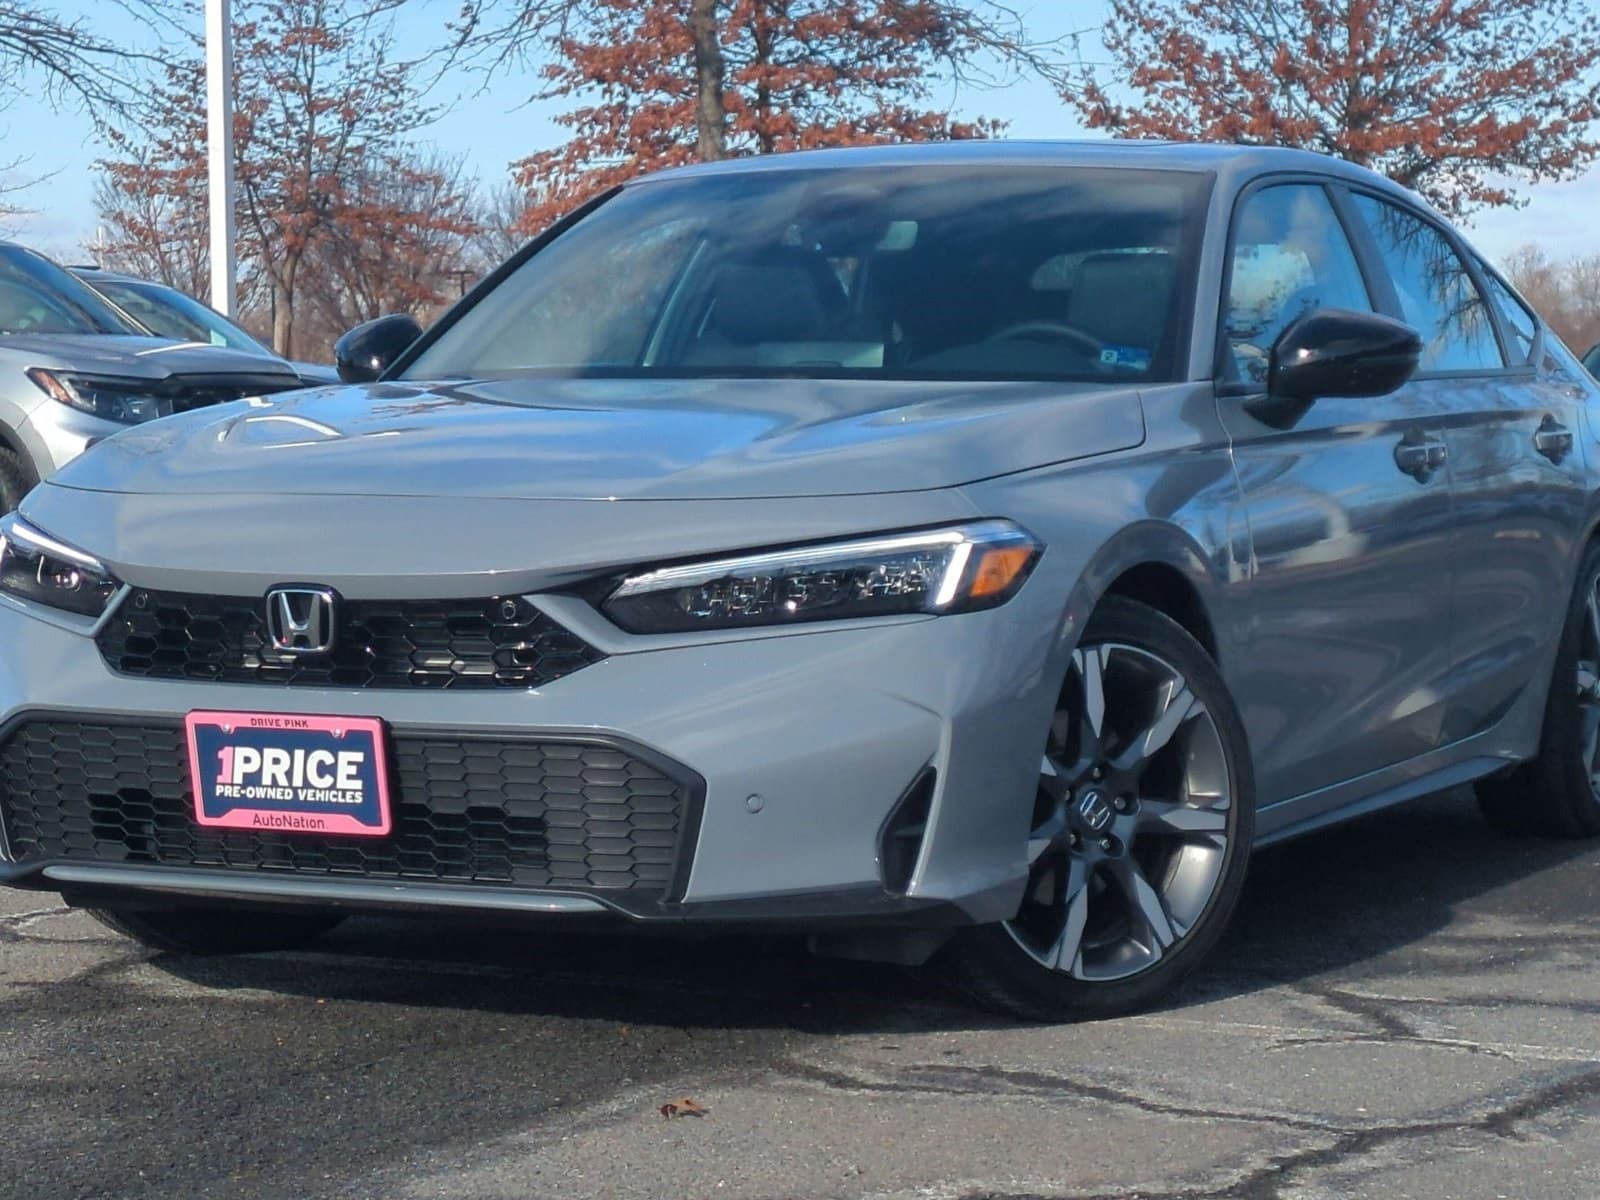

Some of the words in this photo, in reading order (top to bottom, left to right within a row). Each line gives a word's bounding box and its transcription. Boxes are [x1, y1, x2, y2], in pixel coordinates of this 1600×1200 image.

[250, 717, 281, 727] DRIVE
[284, 718, 309, 728] PINK
[215, 784, 293, 801] PRE-OWNED
[297, 788, 364, 804] VEHICLES
[252, 813, 325, 830] AutoNation
